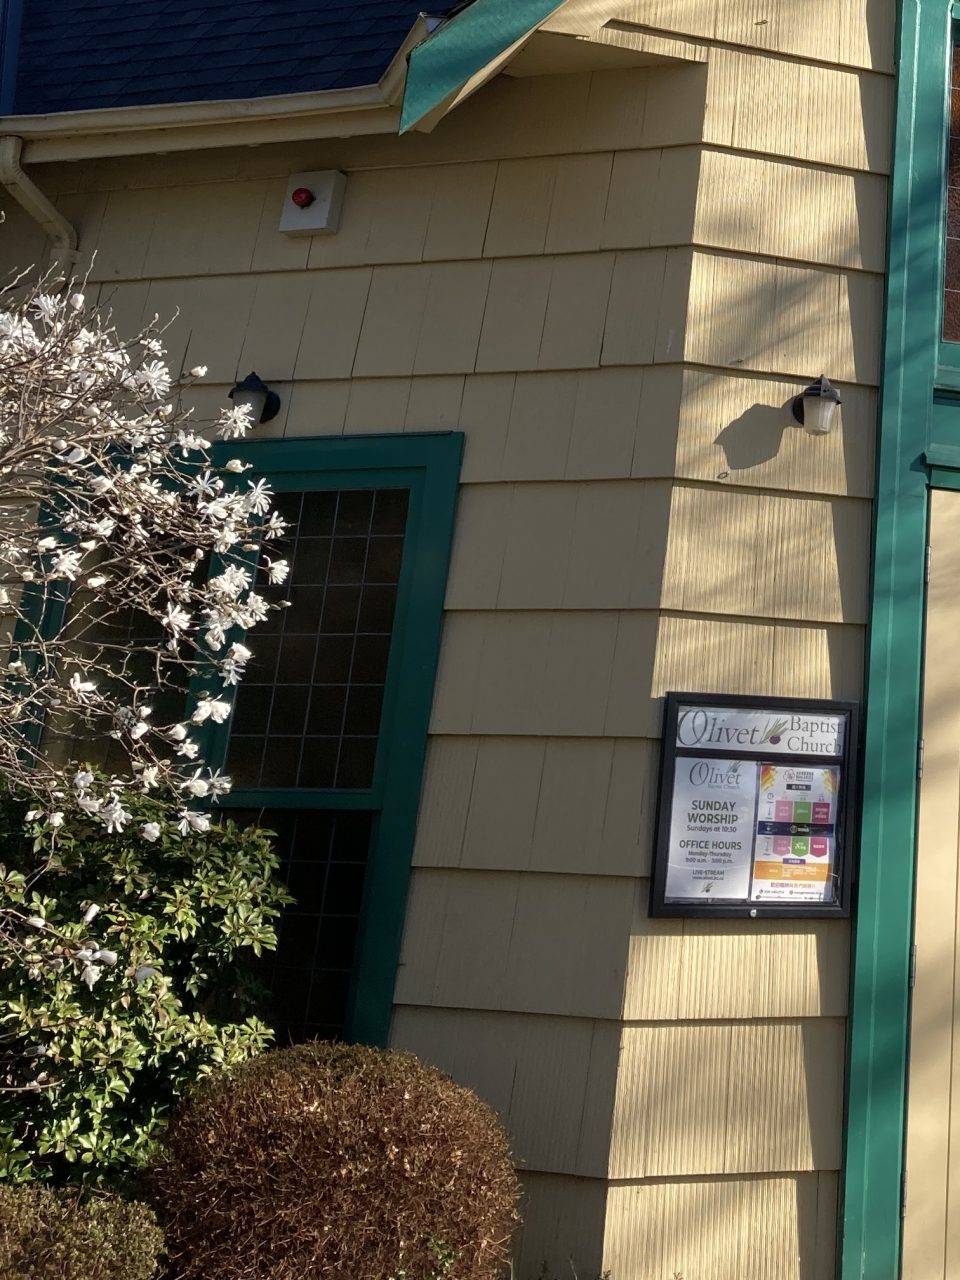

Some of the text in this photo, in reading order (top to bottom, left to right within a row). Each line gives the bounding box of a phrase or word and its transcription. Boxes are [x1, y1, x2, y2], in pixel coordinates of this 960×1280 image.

[678, 709, 760, 746] Olivet
[790, 715, 840, 737] Baptist
[787, 736, 841, 754] Church
[689, 761, 742, 786] Olivet
[691, 799, 736, 811] SUNDAY
[687, 813, 738, 824] WORSHIP
[686, 825, 713, 833] Sundays
[679, 839, 742, 850] OFFICE HOURS
